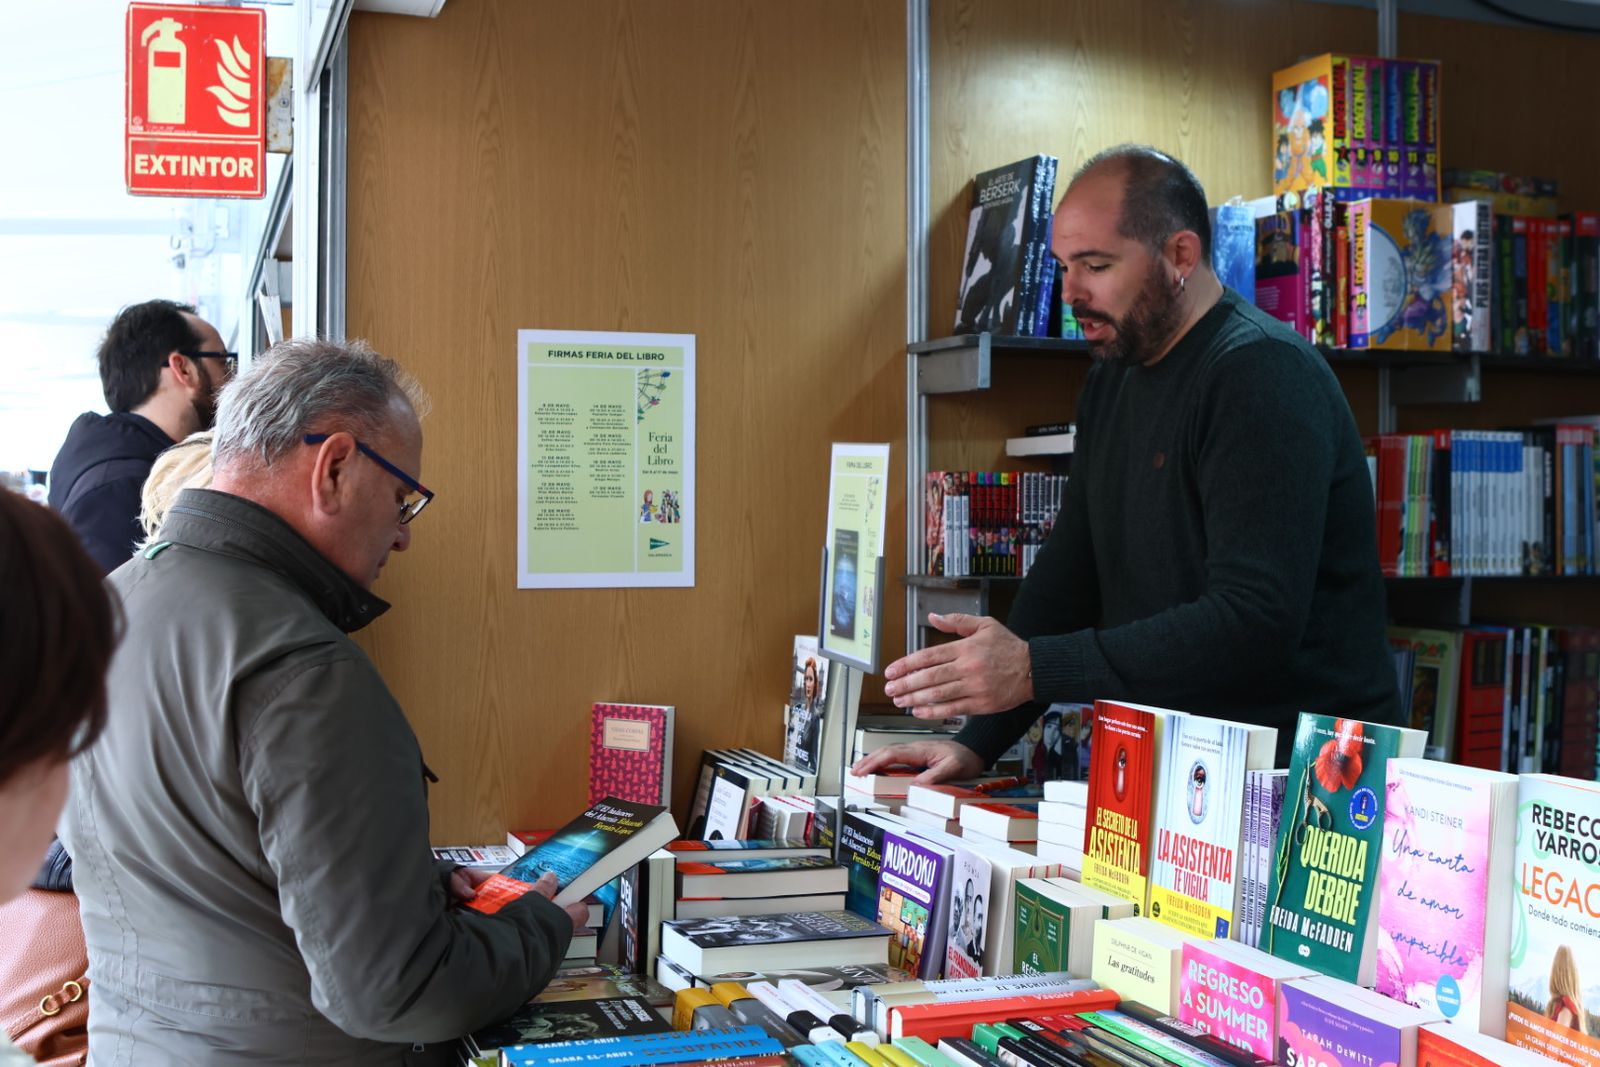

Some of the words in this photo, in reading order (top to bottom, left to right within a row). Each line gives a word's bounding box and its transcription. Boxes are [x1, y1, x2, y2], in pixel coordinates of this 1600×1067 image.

[1354, 65, 1366, 89] BALL
[1354, 92, 1366, 139] DRAGON
[134, 154, 254, 178] EXTINTOR
[980, 178, 1022, 203] BERSERK
[1324, 191, 1335, 229] Anime
[1355, 210, 1364, 238] BALL
[1354, 240, 1364, 287] DRAGON
[1476, 282, 1488, 308] PLUS
[548, 350, 584, 359] FIRMAS
[586, 351, 614, 359] FERIA
[616, 352, 635, 360] DEL
[636, 352, 665, 361] LIBRO
[649, 431, 673, 442] Feria
[653, 443, 668, 454] del
[647, 455, 674, 466] Libro
[584, 810, 599, 818] del
[607, 807, 634, 818] balanceo
[1096, 806, 1103, 827] EL
[1102, 808, 1125, 834] SECRETO
[1124, 816, 1132, 838] DE
[1131, 818, 1138, 840] LA
[1404, 805, 1429, 821] KANDI
[1430, 810, 1463, 830] STEINER
[1532, 803, 1600, 841] REBECC
[840, 834, 849, 845] del
[853, 829, 875, 847] balanceo
[1088, 825, 1141, 876] ASISTENTA
[884, 841, 937, 888] MURDOKU
[1157, 828, 1171, 863] LA
[1171, 832, 1233, 885] ASISTENTA
[1300, 824, 1368, 883] QUERIDA
[1391, 828, 1426, 858] Una
[1426, 849, 1476, 875] carta
[1174, 867, 1183, 892] TE
[1183, 871, 1209, 902] VIGILA
[1166, 894, 1184, 909] FREIDA
[1303, 869, 1363, 927] DEBBIE
[1397, 880, 1417, 902] de
[1420, 896, 1464, 921] amor
[1269, 904, 1299, 933] FREIDA
[1300, 915, 1354, 953] McFADDEN
[1528, 904, 1551, 923] Donde
[1551, 910, 1569, 929] todo
[1032, 952, 1039, 966] EL
[1389, 927, 1468, 967] imposible
[1108, 955, 1120, 968] Las
[1120, 964, 1155, 984] gratitudes
[1016, 980, 1071, 990] SACRIFICIO
[1188, 958, 1264, 1010] REGRESO
[1182, 992, 1193, 1010] A
[1195, 991, 1269, 1042] SUMMER
[537, 1040, 576, 1049] SAARA
[548, 1055, 586, 1064] SAARA
[644, 1038, 761, 1056] CLEOPATRA
[1301, 1028, 1333, 1050] TARAH
[1529, 1022, 1545, 1034] AMOR
[1545, 1028, 1569, 1044] RENACER
[1569, 1039, 1578, 1049] DE
[1578, 1044, 1589, 1054] LAS
[1531, 1036, 1546, 1048] GRAN
[1546, 1043, 1558, 1054] SERIE
